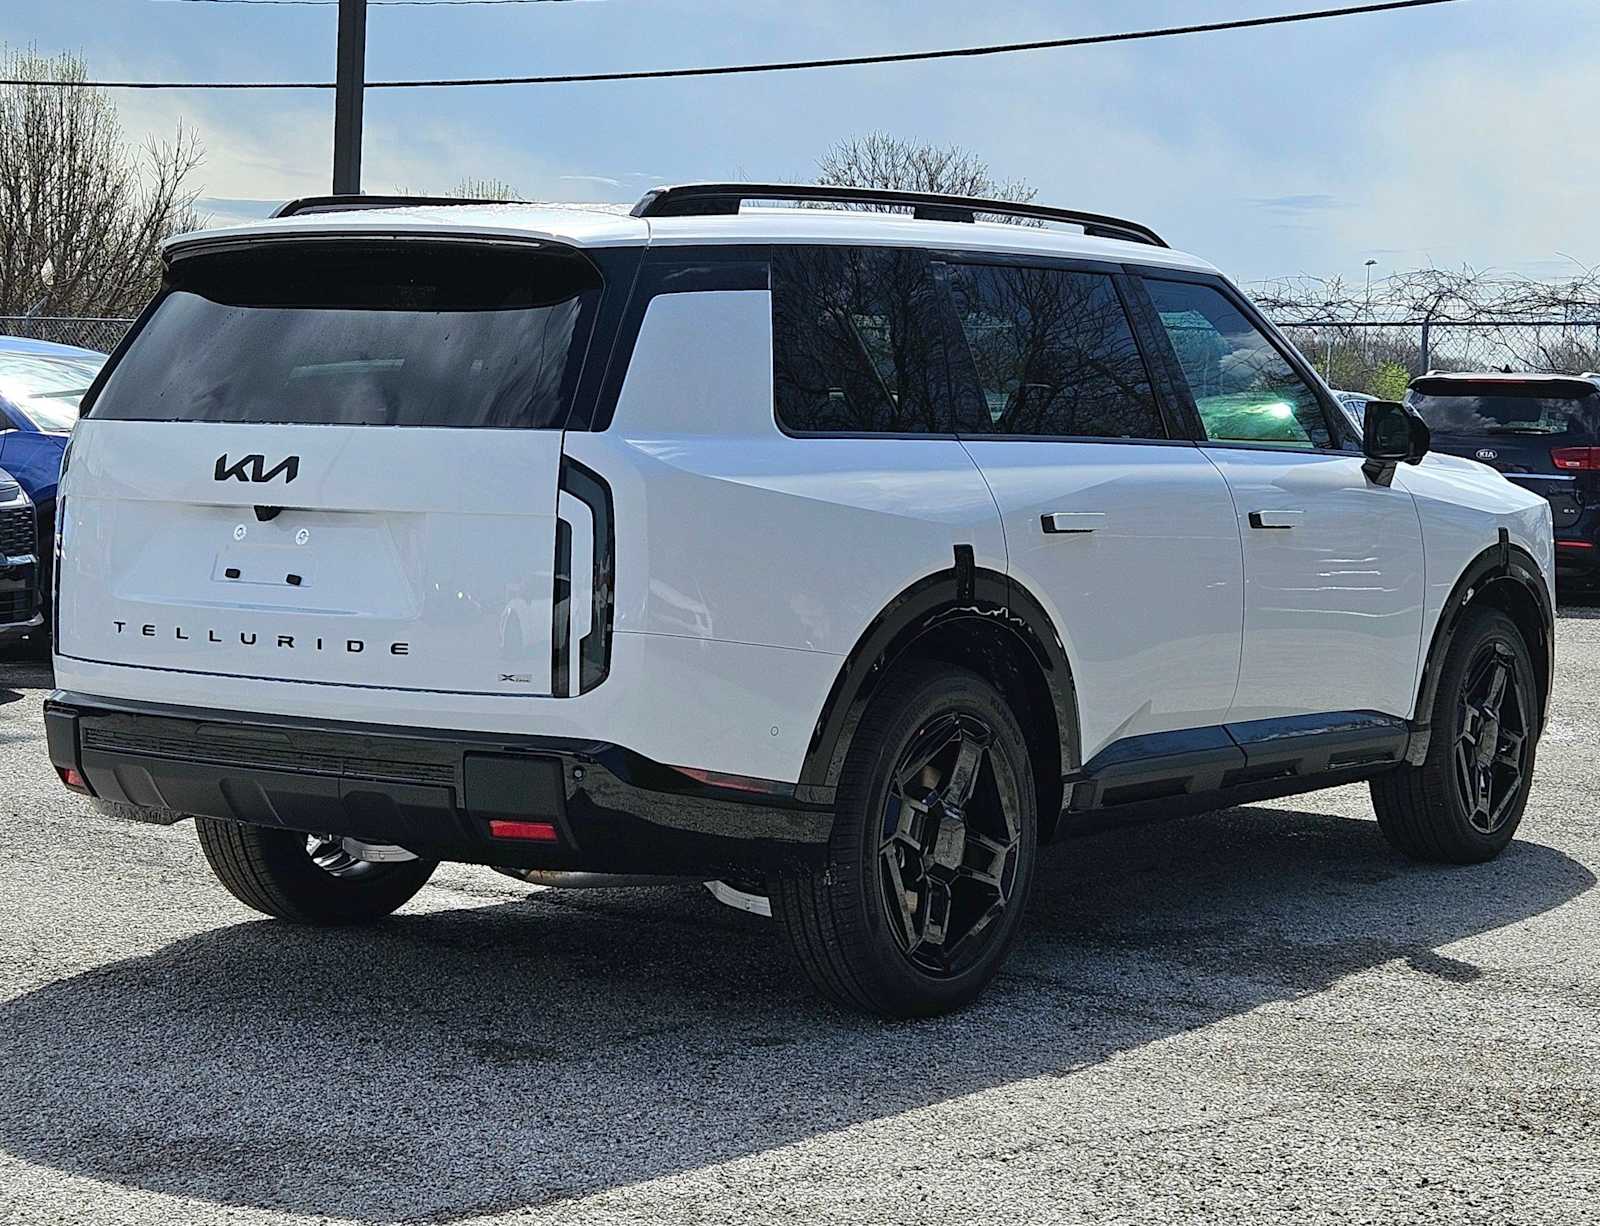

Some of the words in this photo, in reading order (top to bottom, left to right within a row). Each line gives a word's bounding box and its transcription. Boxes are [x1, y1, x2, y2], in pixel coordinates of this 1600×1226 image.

[214, 453, 300, 484] KIA
[1479, 450, 1495, 459] KIA
[113, 621, 409, 656] TELLURIDE
